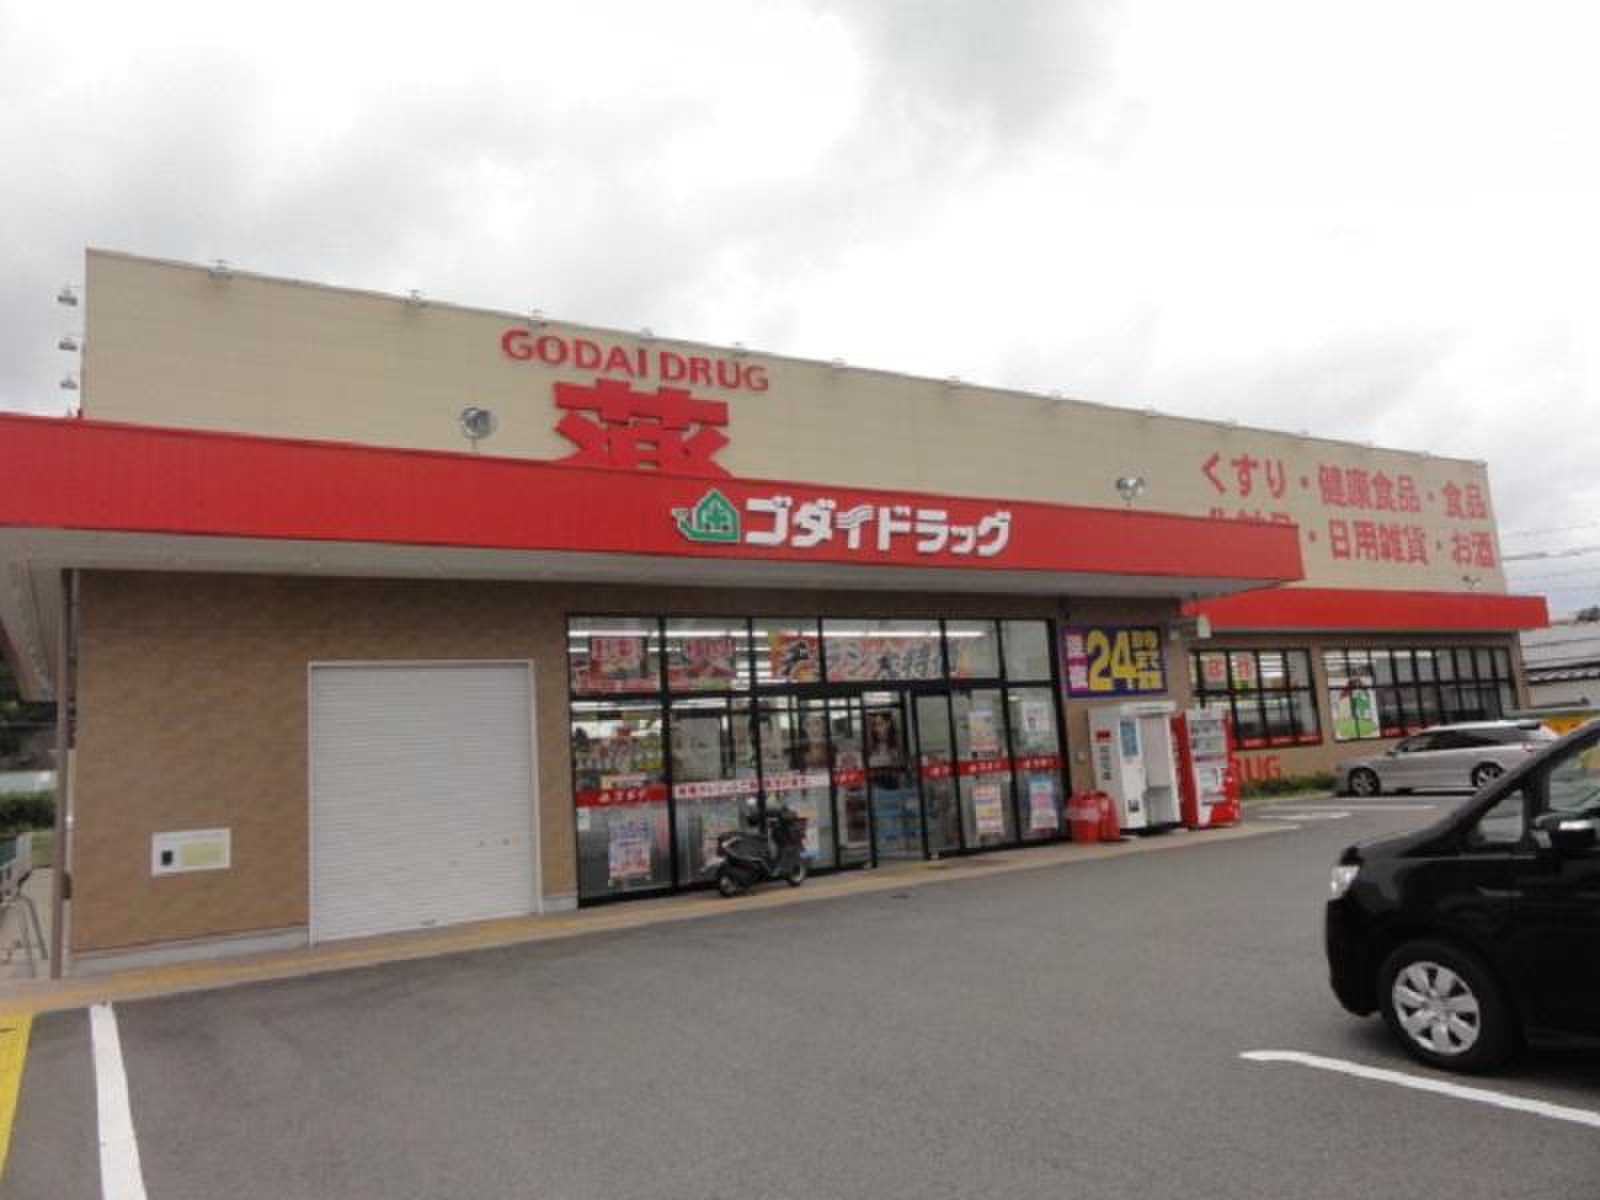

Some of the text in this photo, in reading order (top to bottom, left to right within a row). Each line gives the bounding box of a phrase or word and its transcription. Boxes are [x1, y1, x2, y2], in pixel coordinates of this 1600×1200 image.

[502, 328, 768, 390] GODAI DRUG
[745, 496, 1011, 557] ゴダイドラッグ
